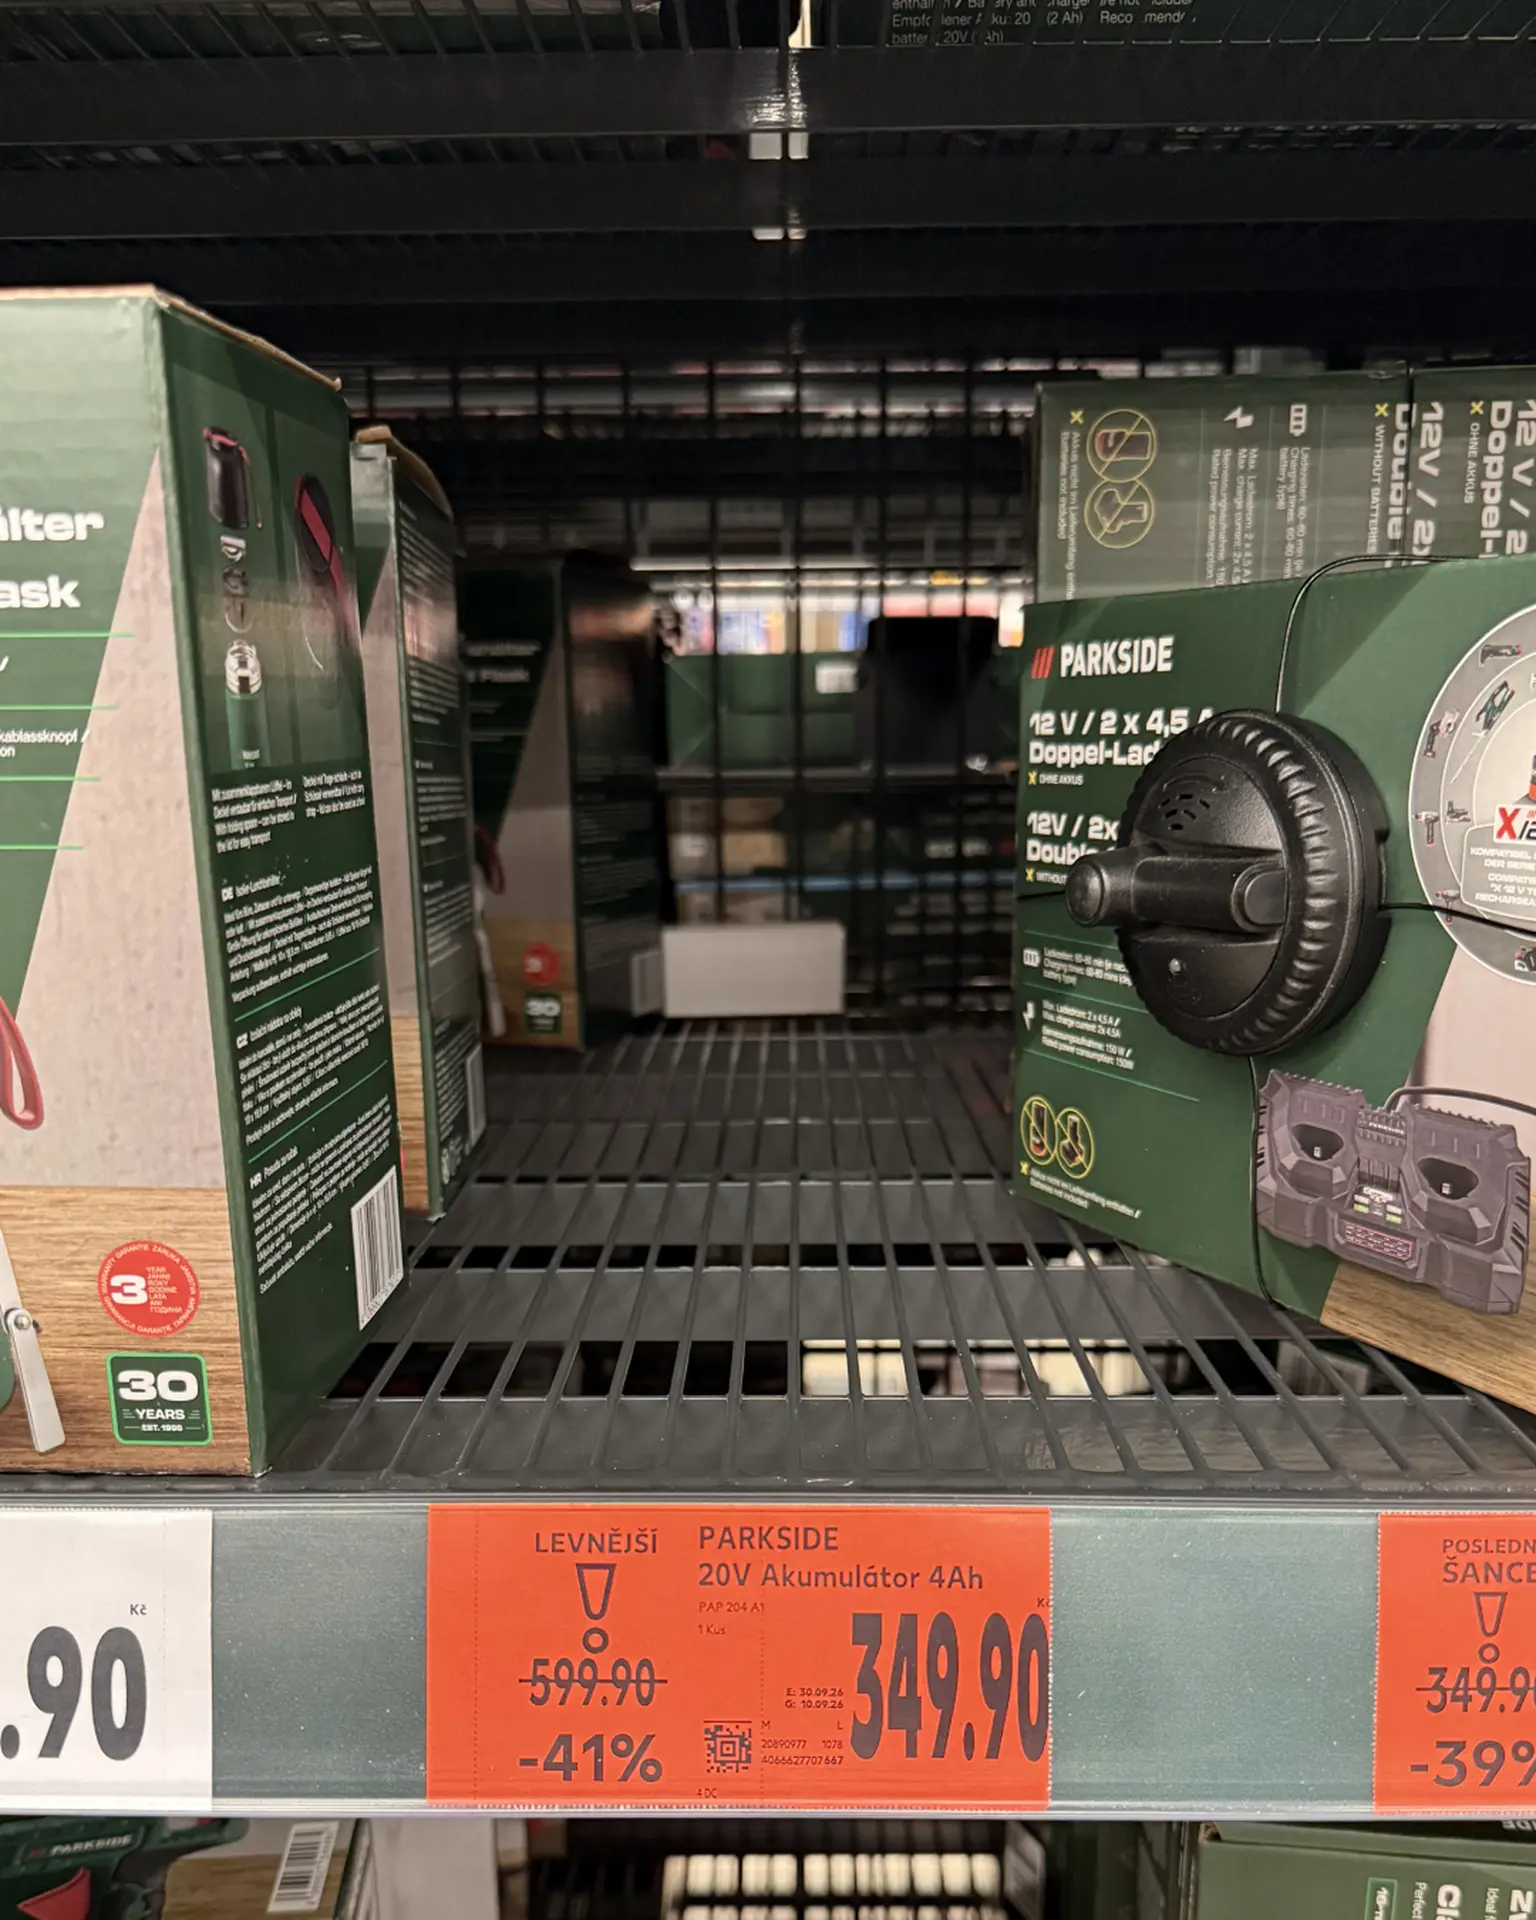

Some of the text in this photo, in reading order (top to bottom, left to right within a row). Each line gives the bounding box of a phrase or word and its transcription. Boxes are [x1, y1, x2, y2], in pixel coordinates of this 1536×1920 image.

[1419, 402, 1444, 477] 12V
[1372, 425, 1386, 483] WITHOUT
[1464, 423, 1480, 504] OHNE AKKUS
[1060, 635, 1174, 678] PARKSIDE
[1029, 711, 1057, 736] 12
[1060, 710, 1078, 735] V
[1081, 710, 1096, 735] /
[1099, 710, 1117, 735] 2
[1122, 712, 1140, 735] x
[1028, 741, 1160, 768] Doppel-Lad
[1027, 811, 1068, 837] 12V
[1488, 872, 1536, 885] COMPATI
[110, 1274, 149, 1305] 3
[118, 1370, 199, 1402] 30
[136, 1408, 186, 1420] YEARS
[141, 1424, 160, 1432] EST.
[535, 1528, 658, 1553] LEVNĚJŠÍ
[699, 1526, 839, 1551] PARKSIDE
[699, 1562, 985, 1590] 20V Akumulátor 4Ah
[130, 1603, 148, 1616] Kč
[698, 1602, 765, 1613] PAP 204 A1
[705, 1624, 727, 1635] Kus
[0, 1625, 148, 1762] .90
[529, 1657, 656, 1707] 599.90
[785, 1687, 844, 1698] E: 30.09.26
[850, 1611, 1050, 1762] 349.90
[1425, 1666, 1536, 1715] 349.9
[784, 1699, 844, 1709] G: 10.09.26
[761, 1739, 844, 1750] 20890977 1078
[518, 1733, 664, 1783] -41%
[49, 1834, 133, 1856] PARKSIDE
